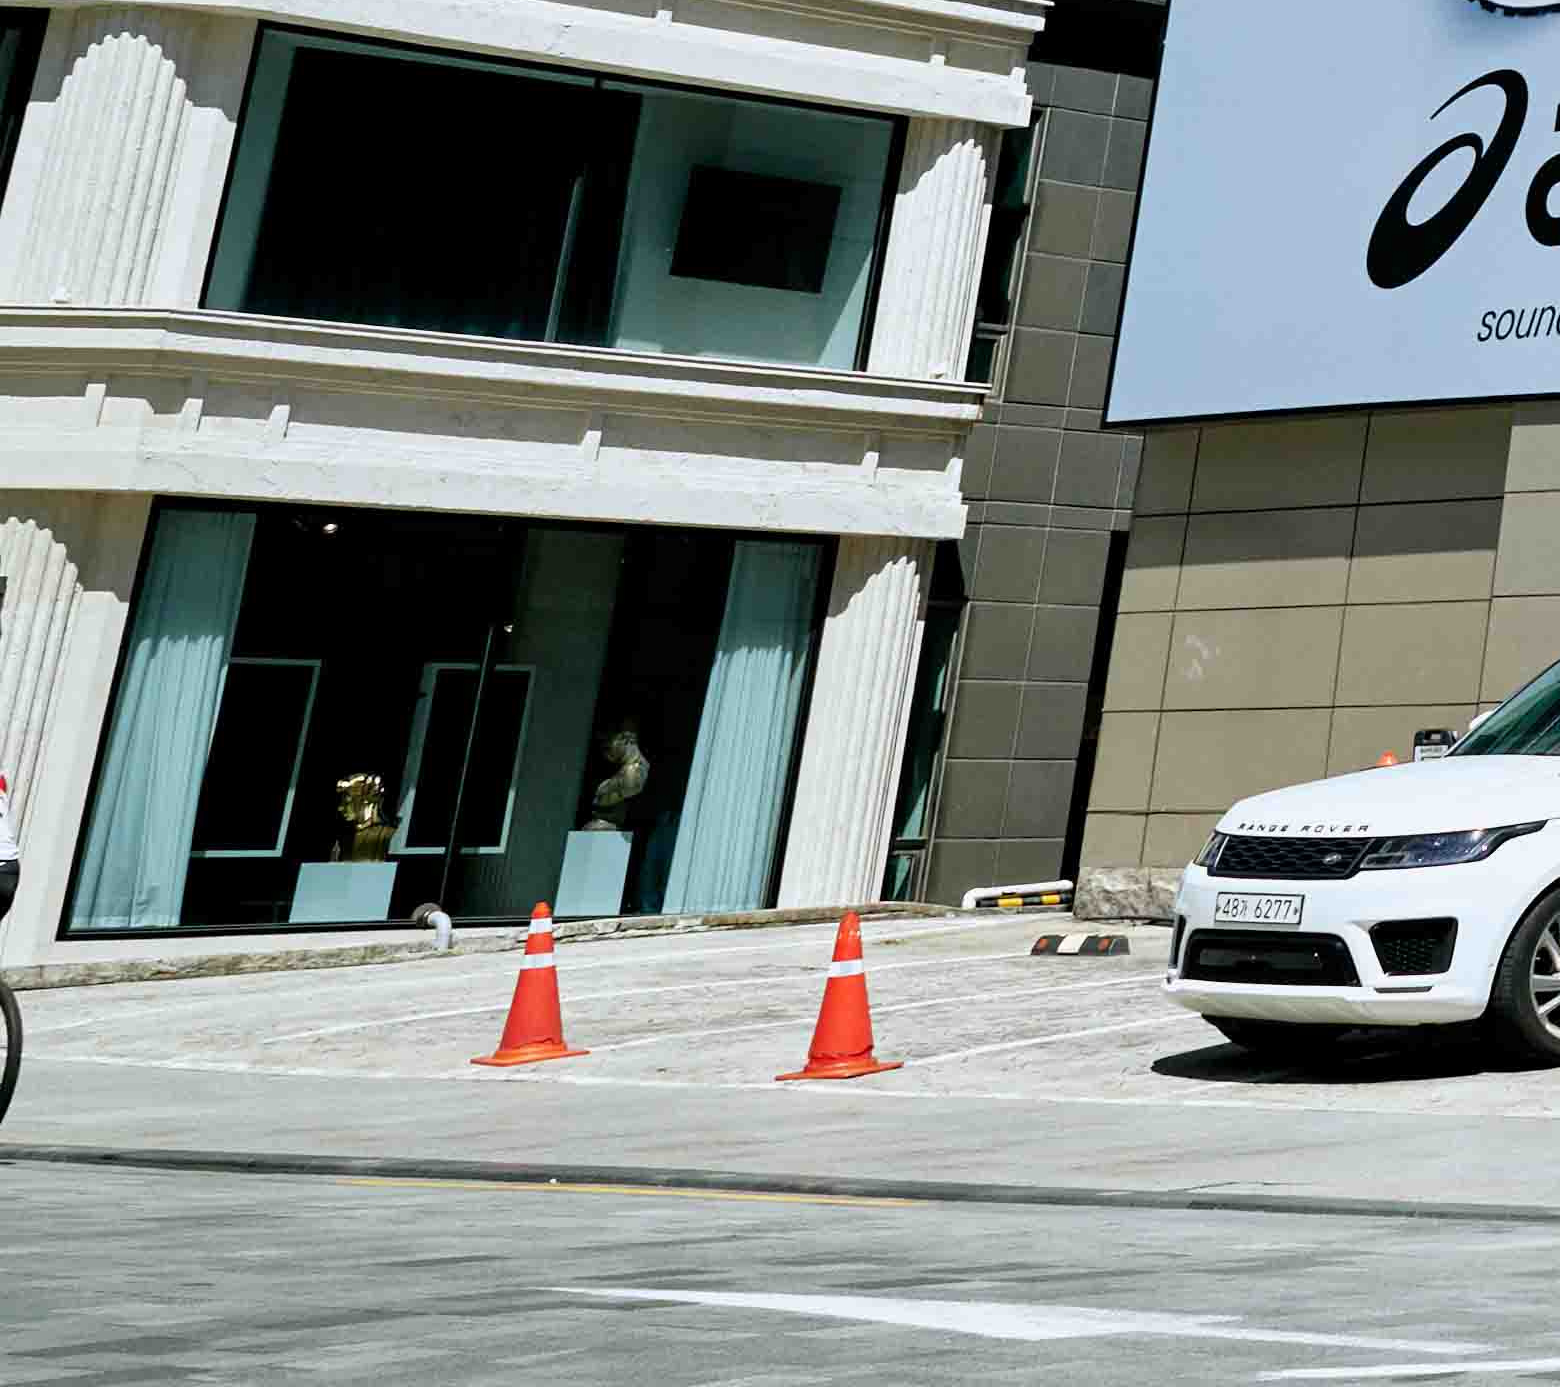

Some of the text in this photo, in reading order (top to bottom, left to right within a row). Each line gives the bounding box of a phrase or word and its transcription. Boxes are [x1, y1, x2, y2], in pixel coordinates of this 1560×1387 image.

[1237, 822, 1370, 834] RANGE ROVER
[1254, 898, 1293, 921] 6277
